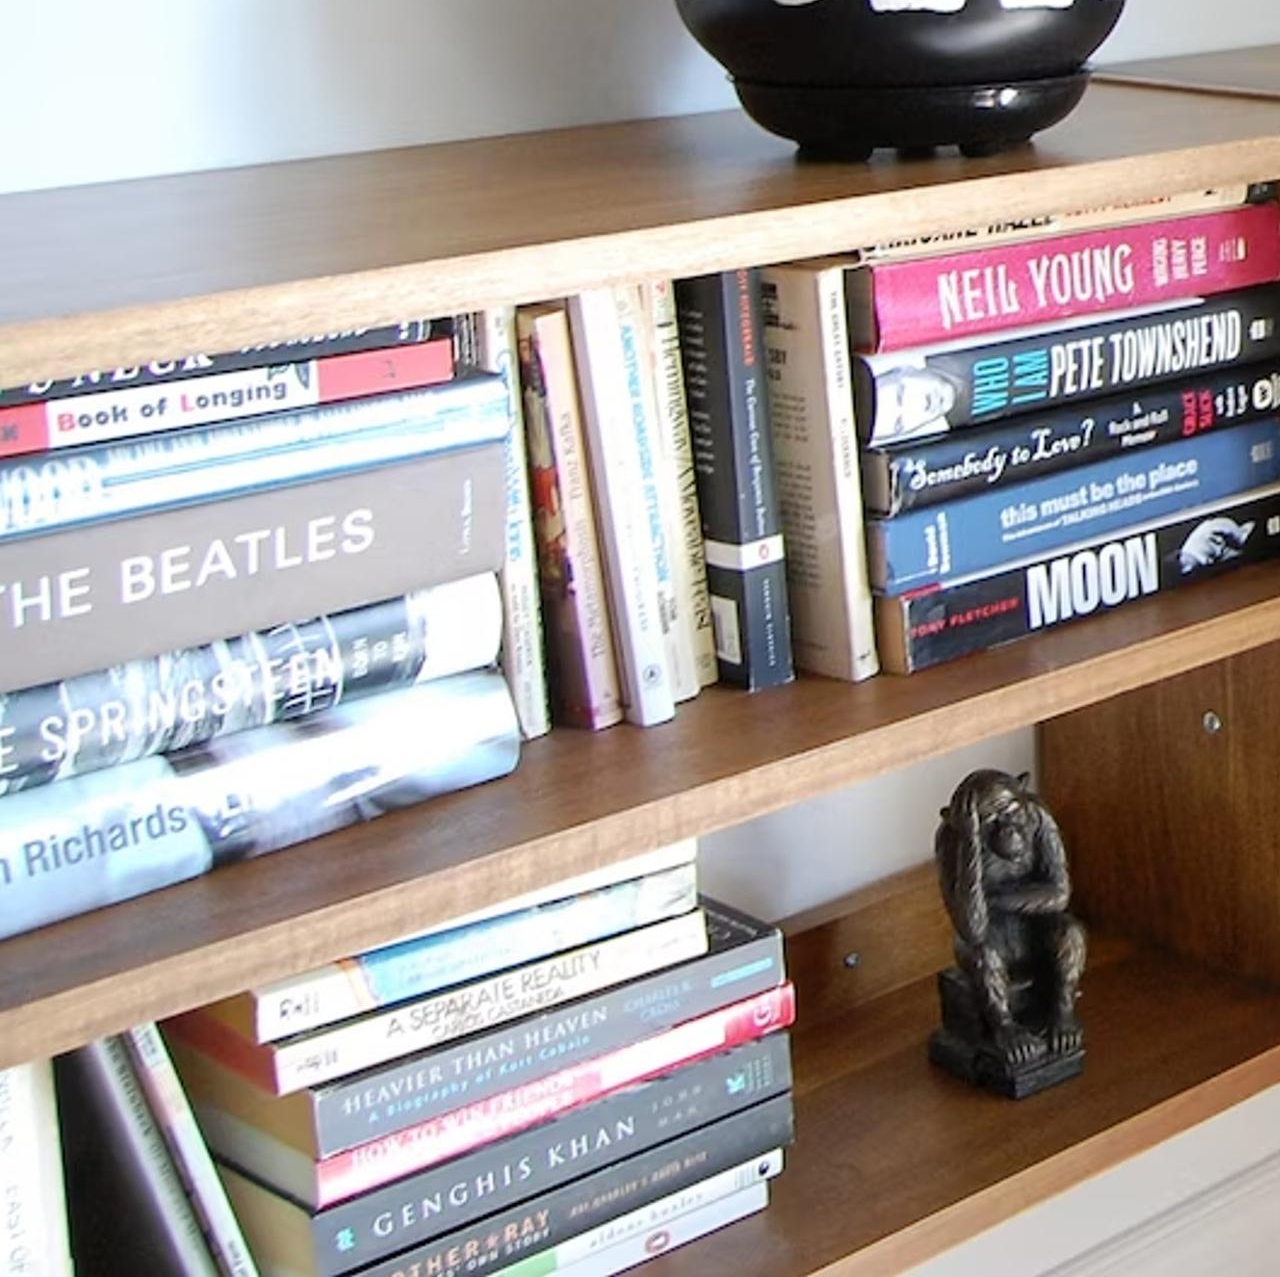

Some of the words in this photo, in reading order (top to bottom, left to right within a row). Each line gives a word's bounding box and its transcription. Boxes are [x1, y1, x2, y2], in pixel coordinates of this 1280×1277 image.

[937, 267, 1020, 331] NEIL
[1027, 243, 1133, 309] YOUNG
[618, 325, 642, 400] ANOTHER
[738, 294, 754, 366] FITZGERALD
[1050, 336, 1104, 398] PETE
[1109, 310, 1241, 385] TOWNSHEND
[745, 378, 757, 395] The
[971, 357, 1009, 415] WHO
[1011, 390, 1047, 404] I
[1012, 349, 1048, 386] AM
[56, 405, 128, 432] Book
[140, 397, 168, 418] of
[180, 381, 288, 413] Longing
[557, 410, 578, 457] Kafka
[630, 401, 655, 480] ROADSIDE
[748, 433, 760, 454] Case
[905, 453, 1006, 491] Somebody
[1012, 443, 1029, 466] to
[1031, 418, 1096, 459] Love?
[563, 459, 584, 502] Franz
[1000, 503, 1038, 529] this
[1040, 490, 1088, 518] must
[1090, 479, 1114, 500] be
[1117, 471, 1147, 493] the
[1149, 458, 1199, 485] place
[1061, 504, 1107, 526] TALKING
[1108, 493, 1143, 515] HEADS
[120, 508, 376, 605] BEATLES
[641, 482, 671, 584] ATTRACTION
[909, 617, 946, 640] TONY
[949, 596, 1020, 628] FLETCHER
[1026, 531, 1160, 629] MOON
[40, 645, 342, 761] SPRINGSTEEN
[24, 803, 188, 878] Richards
[386, 1017, 404, 1039] A
[410, 979, 514, 1031] SEPARATE
[520, 949, 601, 995] REALITY
[342, 1064, 444, 1117] HEAVIER
[452, 1039, 516, 1076] THAN
[525, 1006, 608, 1050] HEAVEN
[367, 1110, 379, 1124] A
[387, 1079, 469, 1119] Biography
[475, 1069, 491, 1084] of
[498, 1055, 534, 1076] Kurt
[539, 1034, 591, 1060] Cobain
[350, 1138, 404, 1166] HOW
[409, 1123, 438, 1145] TO
[372, 1155, 533, 1237] GENGHIS
[547, 1115, 636, 1169] KHAN
[466, 1249, 499, 1270] OWN
[505, 1227, 551, 1254] STORY
[503, 1209, 551, 1243] RAY
[589, 1218, 644, 1250] aldous
[650, 1191, 704, 1222] huxley
